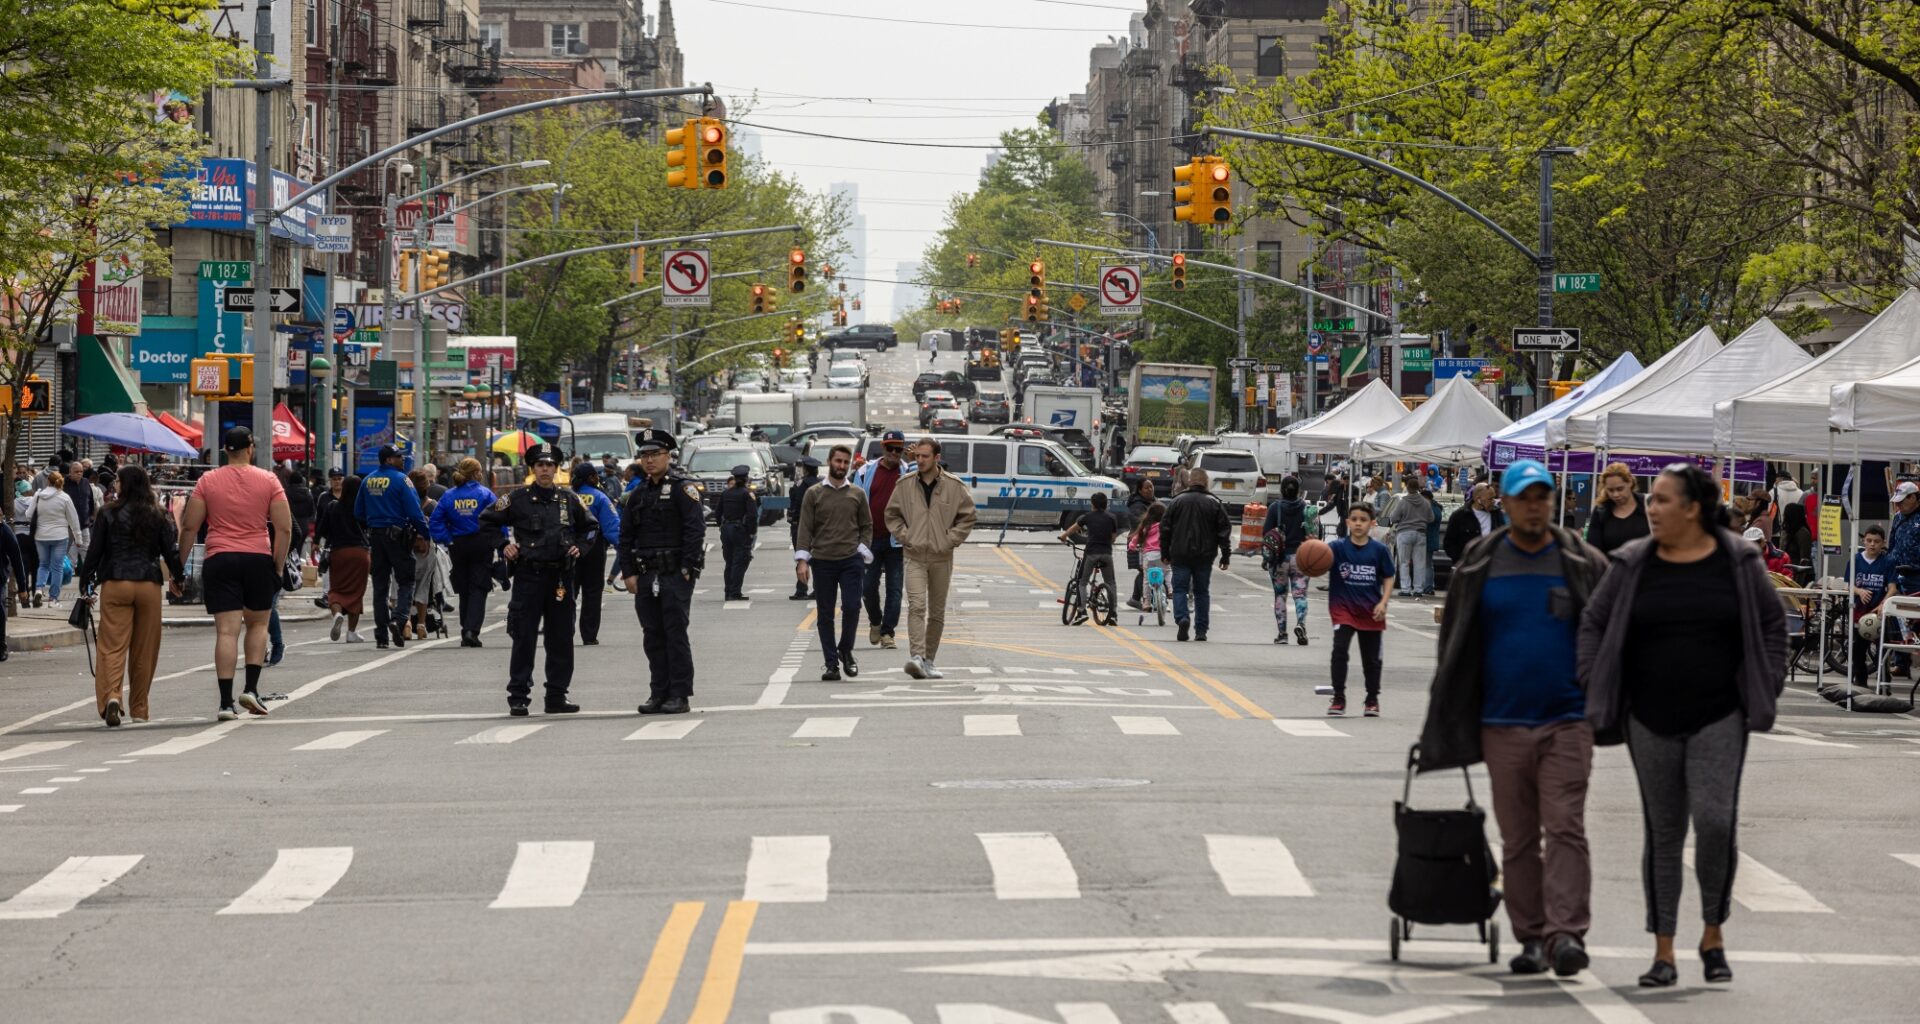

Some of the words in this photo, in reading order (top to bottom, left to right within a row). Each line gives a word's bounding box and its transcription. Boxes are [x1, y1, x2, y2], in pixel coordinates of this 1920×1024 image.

[212, 166, 236, 189] Yes
[191, 185, 241, 201] DENTAL
[321, 217, 347, 226] NYPD
[315, 234, 351, 243] SECURITY
[318, 242, 349, 250] CAMERA
[202, 263, 213, 278] W
[218, 263, 237, 278] 182
[242, 264, 249, 273] St
[1558, 276, 1567, 289] W
[1570, 276, 1586, 289] 182
[1589, 275, 1596, 283] St
[97, 285, 138, 323] PIZZERIA
[232, 294, 253, 305] ONE
[360, 331, 371, 341] 181
[1522, 335, 1542, 345] ONE
[1550, 335, 1569, 345] WAY
[139, 350, 188, 363] Doctor
[1403, 349, 1411, 358] W
[1412, 349, 1423, 358] 181
[1457, 360, 1491, 368] RESTRICTIO
[366, 477, 390, 489] NYPD
[1088, 481, 1105, 489] POLICE
[1577, 482, 1585, 493] P
[998, 486, 1054, 498] NYPD
[454, 499, 478, 509] NYPD
[1350, 565, 1376, 575] USA
[1862, 573, 1884, 583] USA
